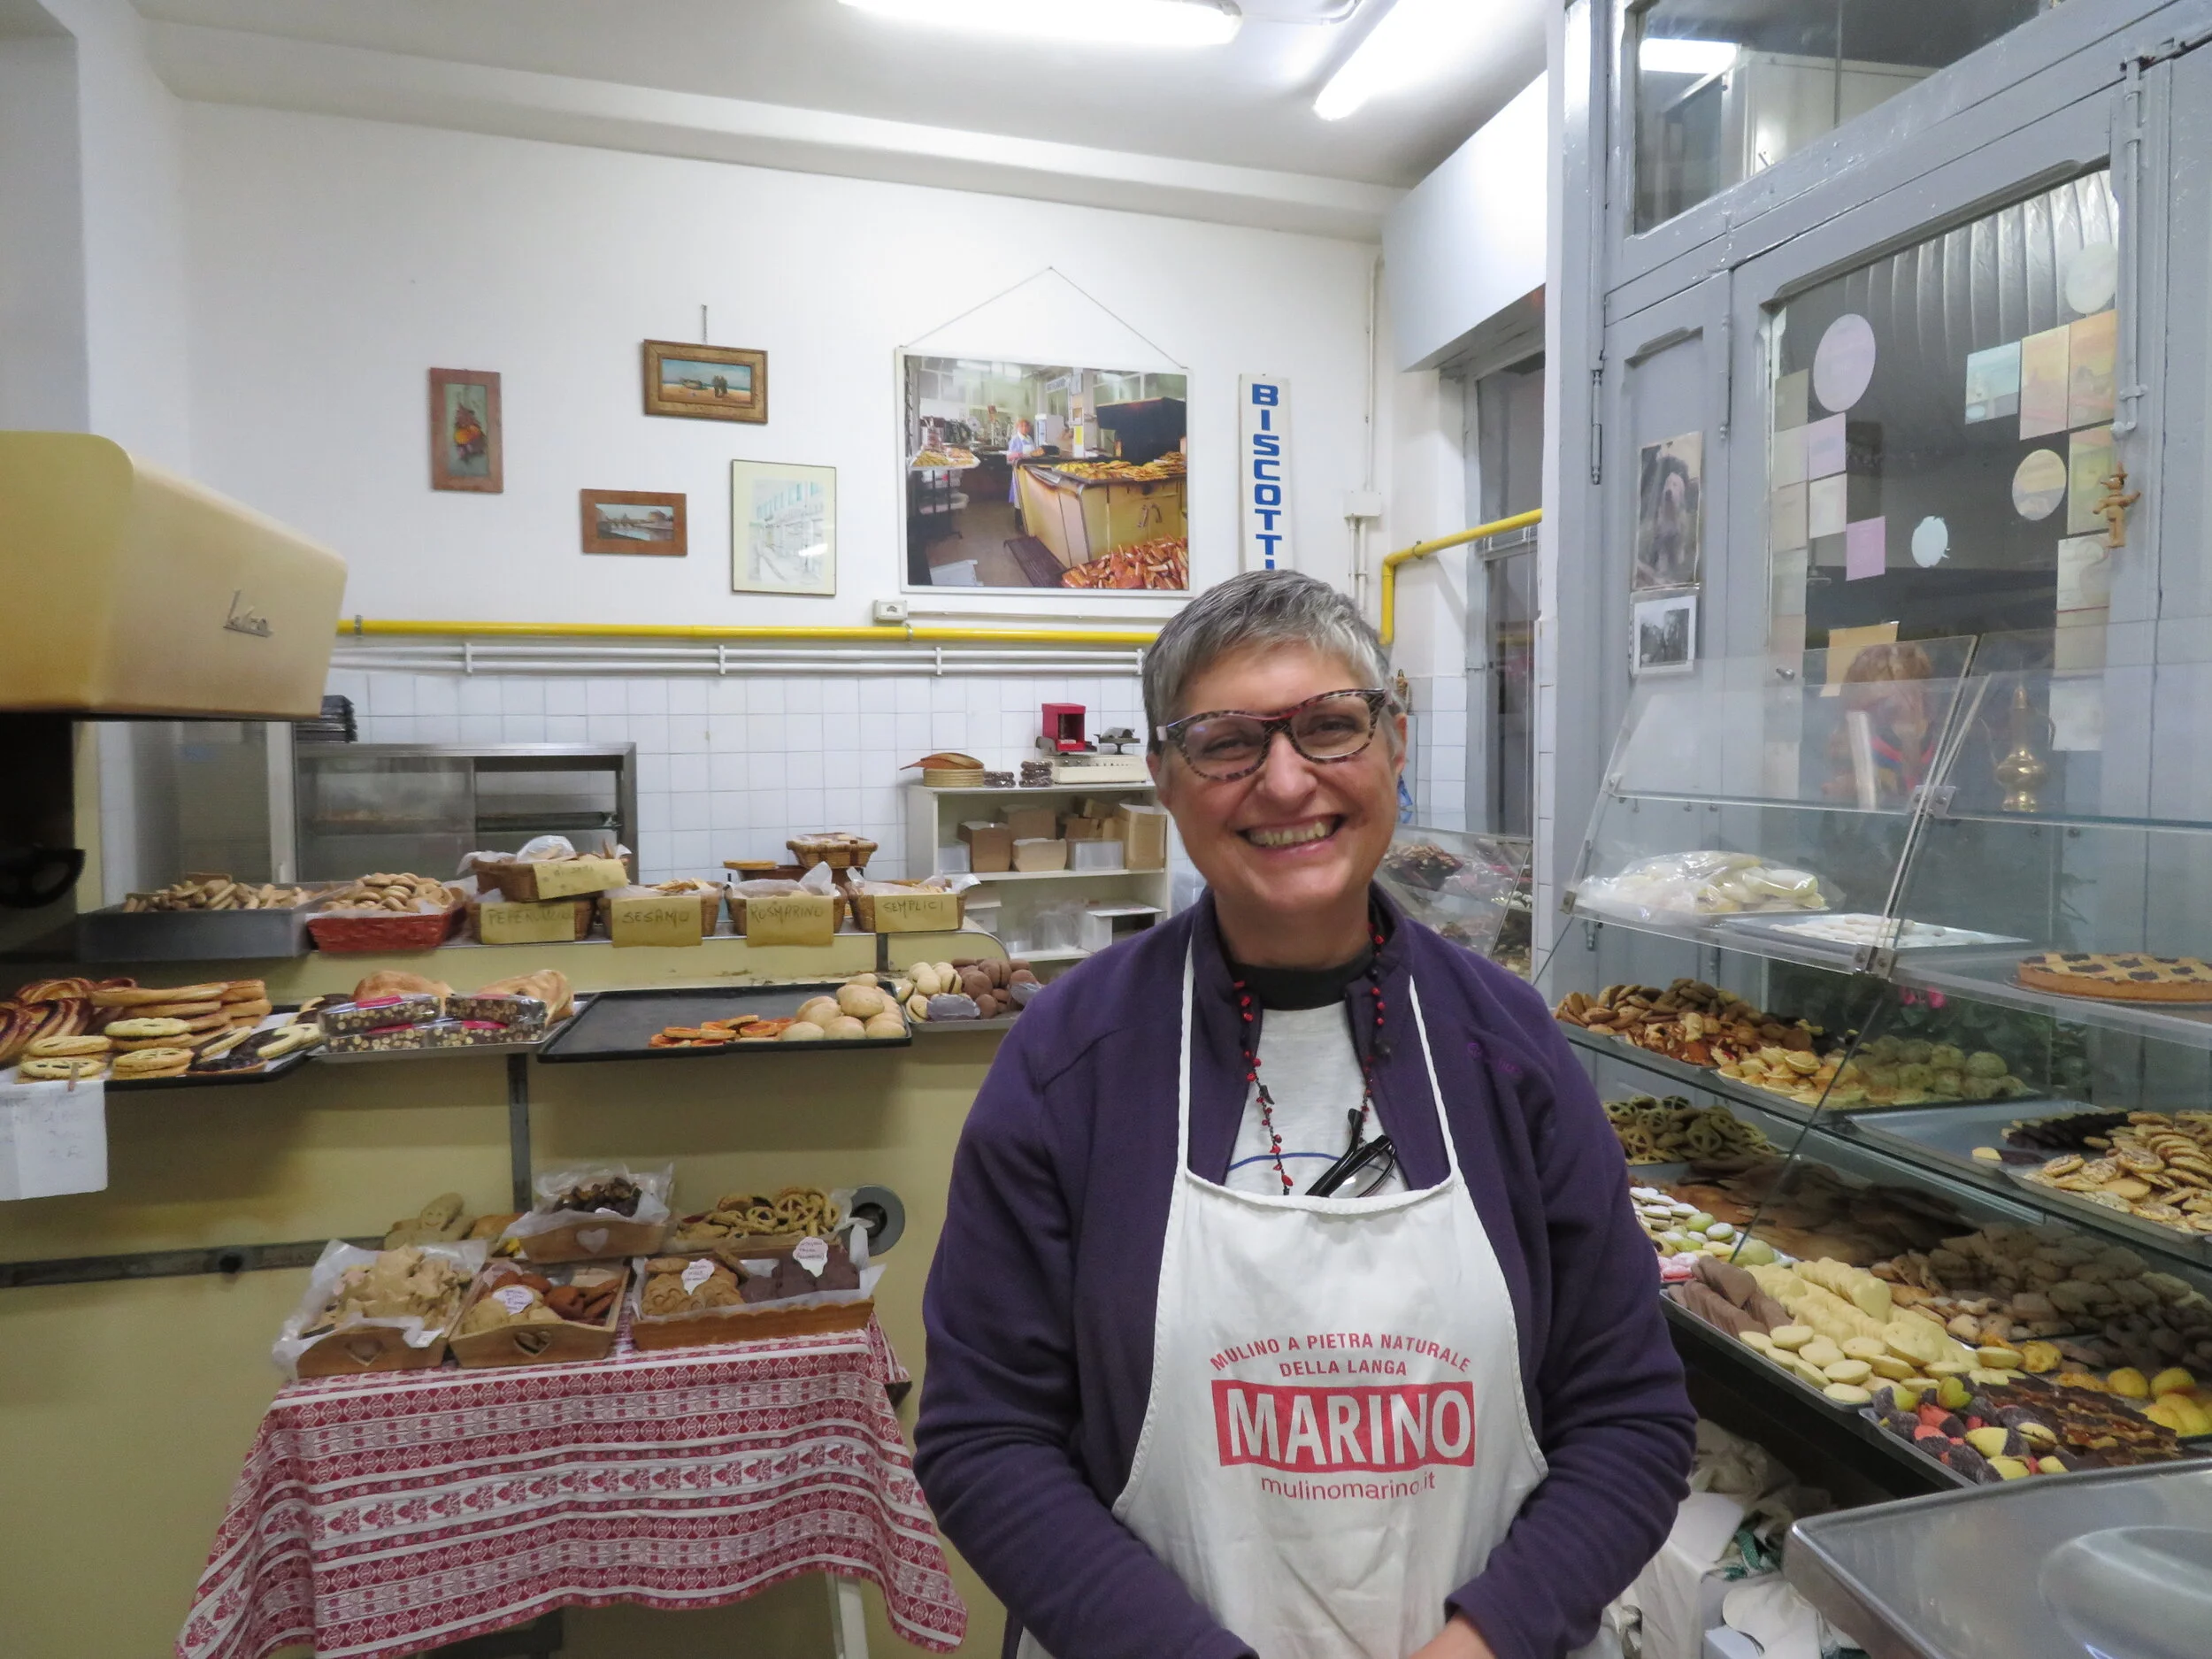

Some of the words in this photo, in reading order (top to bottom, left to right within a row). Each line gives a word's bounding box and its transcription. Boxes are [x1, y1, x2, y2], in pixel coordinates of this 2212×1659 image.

[622, 909, 689, 927] SESAMO
[749, 903, 824, 926] ROSMARINO
[882, 899, 944, 919] SEMPLICI
[1210, 1338, 1280, 1371] MULINO
[1288, 1336, 1301, 1351] A
[1307, 1333, 1373, 1349] PIETRA
[1381, 1333, 1471, 1373] NATURALE
[1279, 1360, 1340, 1377] DELLA
[1348, 1359, 1407, 1376] LANGA
[1227, 1388, 1471, 1465] MARINO
[1260, 1471, 1436, 1502] mulinomarino.it
